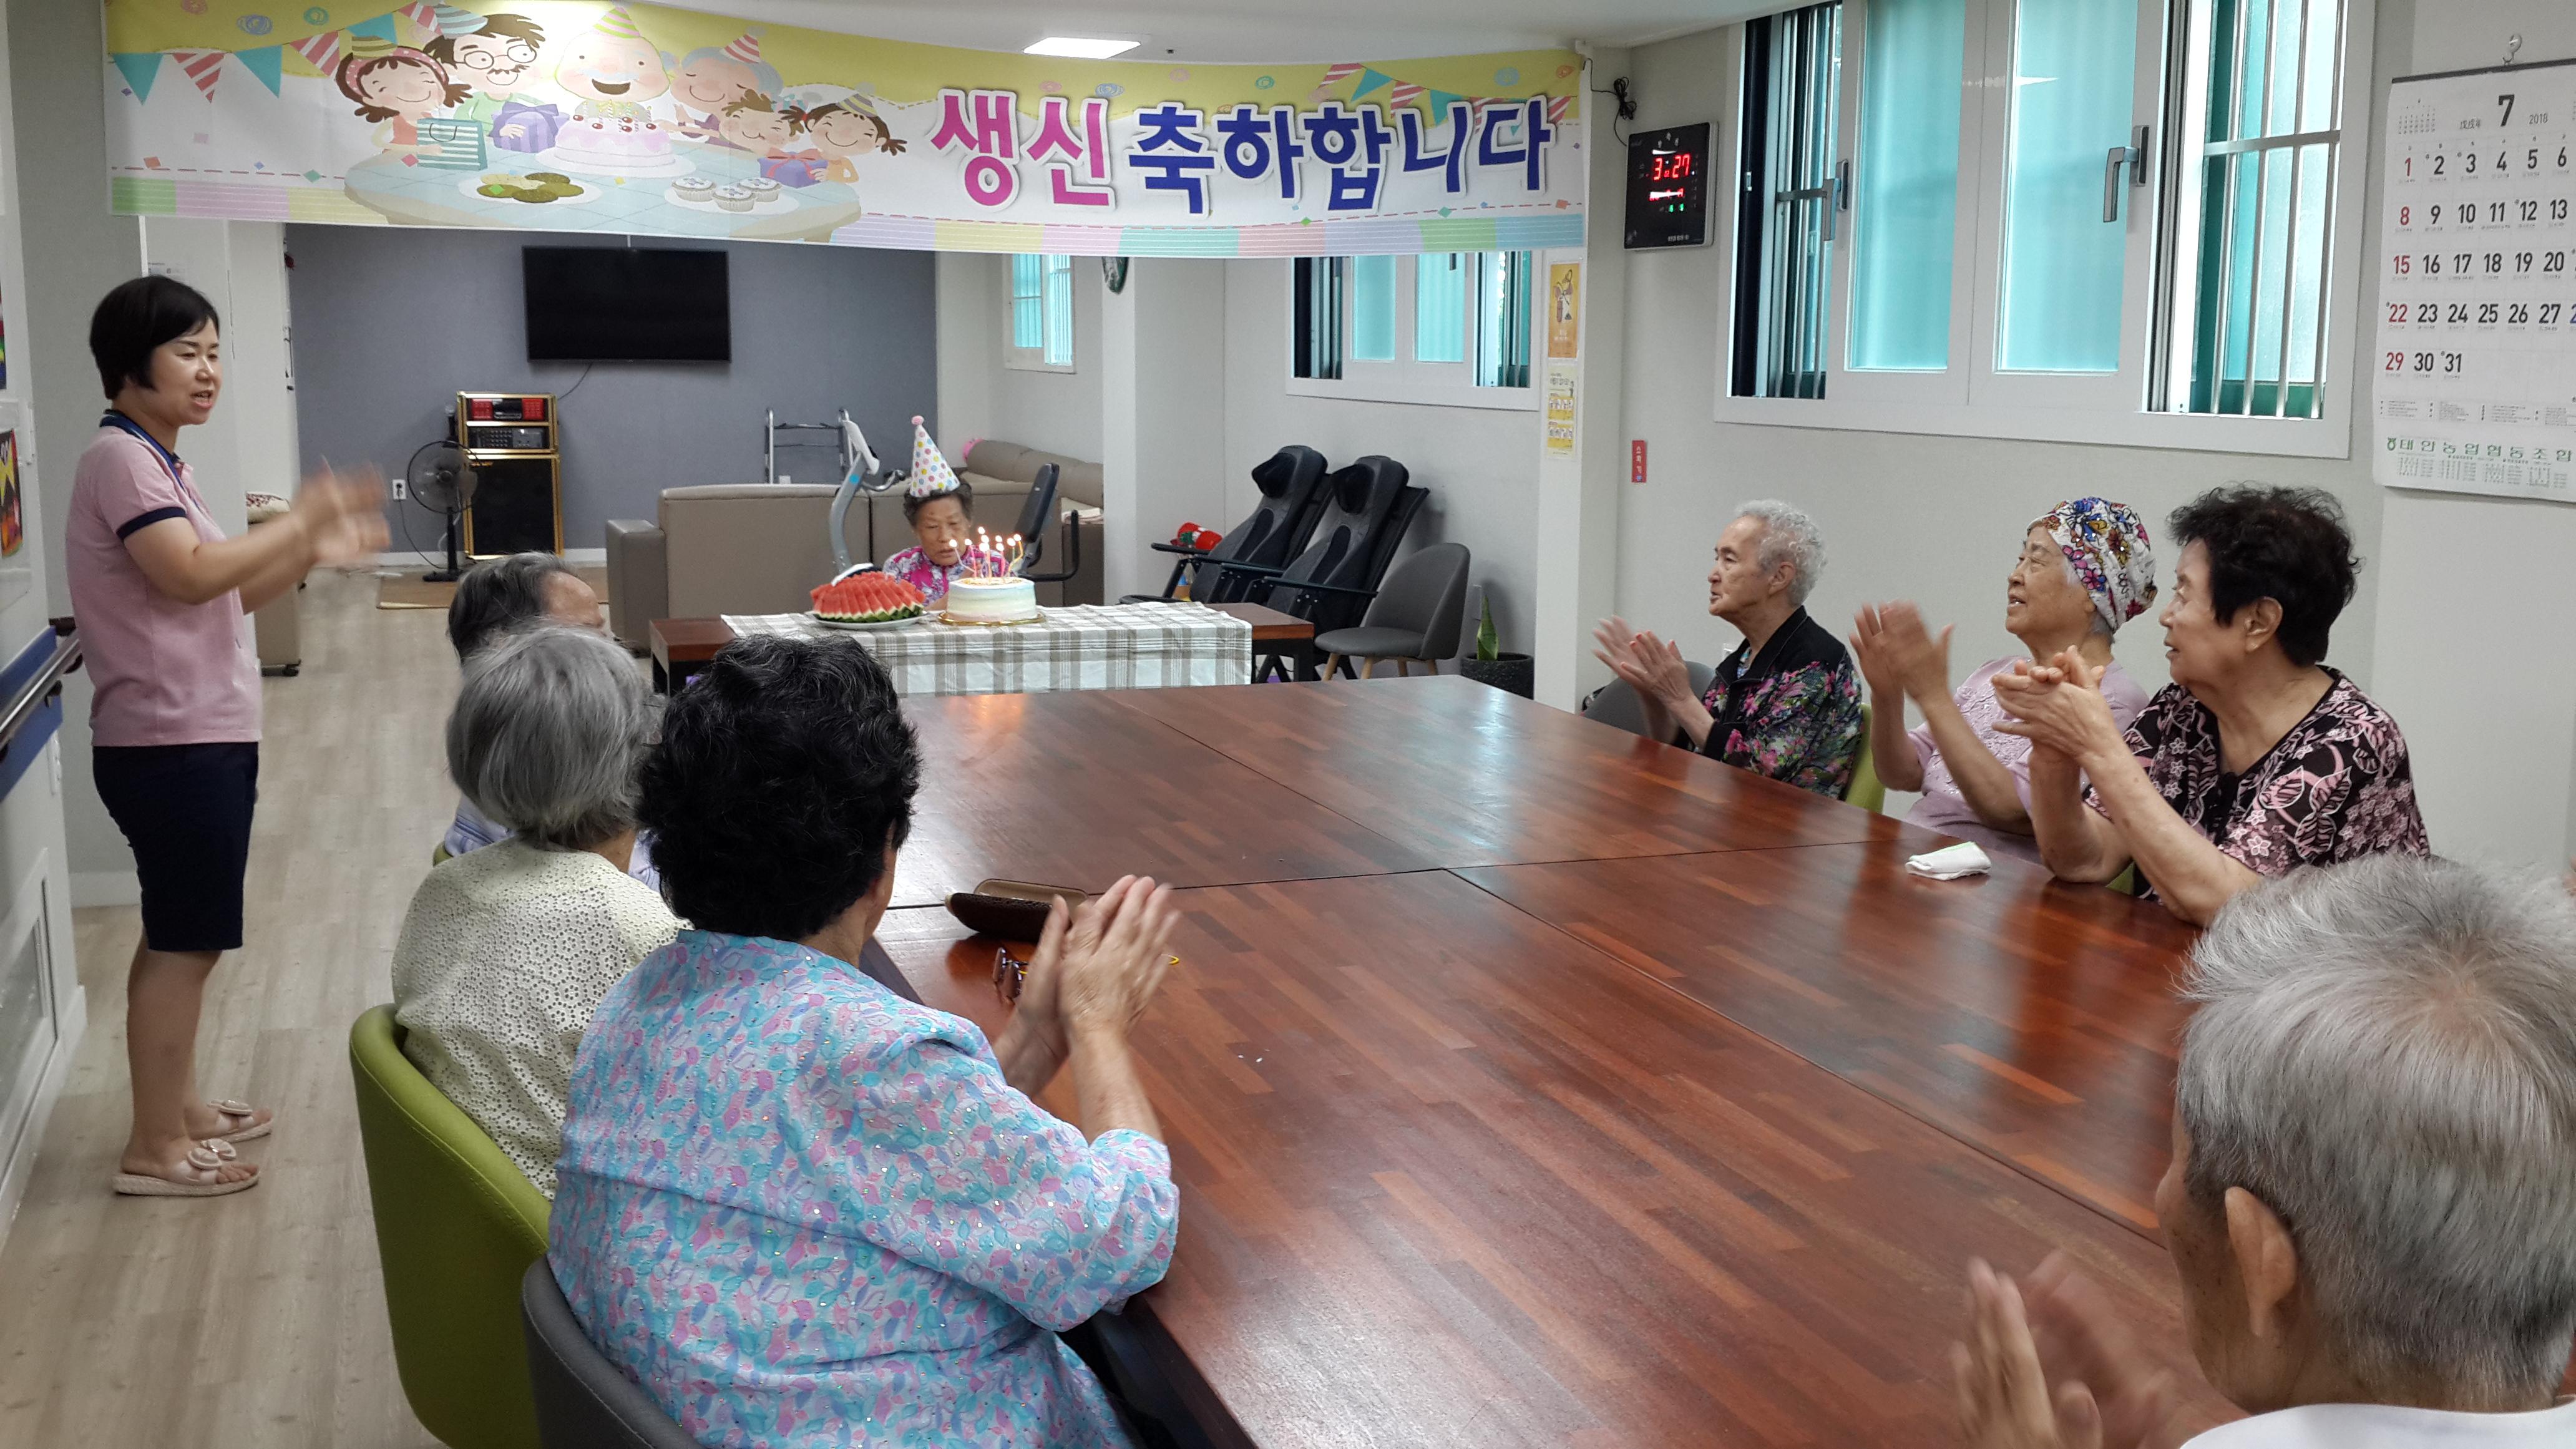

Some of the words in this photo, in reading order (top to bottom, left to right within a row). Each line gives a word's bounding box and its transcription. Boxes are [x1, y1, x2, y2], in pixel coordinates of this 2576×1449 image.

[2498, 94, 2515, 127] 7
[2529, 112, 2549, 125] 2018
[930, 94, 1110, 207] 생신
[1128, 99, 1551, 215] 축하합니다
[2404, 157, 2411, 177] 1
[2434, 155, 2444, 175] 2
[2466, 154, 2476, 173] 3
[2496, 151, 2507, 171] 4
[2527, 149, 2539, 169] 5
[2557, 146, 2567, 167] 6
[2400, 206, 2410, 226] 8
[2431, 205, 2441, 225] 9
[2458, 203, 2476, 224] 10
[2489, 202, 2505, 222] 11
[2520, 200, 2538, 221] 12
[2550, 198, 2568, 220] 13
[2393, 255, 2411, 275] 15
[2422, 254, 2441, 274] 16
[2454, 253, 2472, 273] 17
[2484, 253, 2502, 273] 18
[2515, 252, 2533, 273] 19
[2543, 251, 2565, 272] 20
[2388, 303, 2408, 323] 22
[2417, 303, 2438, 323] 23
[2447, 303, 2468, 323] 24
[2478, 303, 2499, 323] 25
[2508, 303, 2528, 324] 26
[2539, 303, 2561, 324] 27
[2385, 352, 2404, 371] 29
[2414, 352, 2434, 372] 30
[2445, 353, 2462, 373] 31
